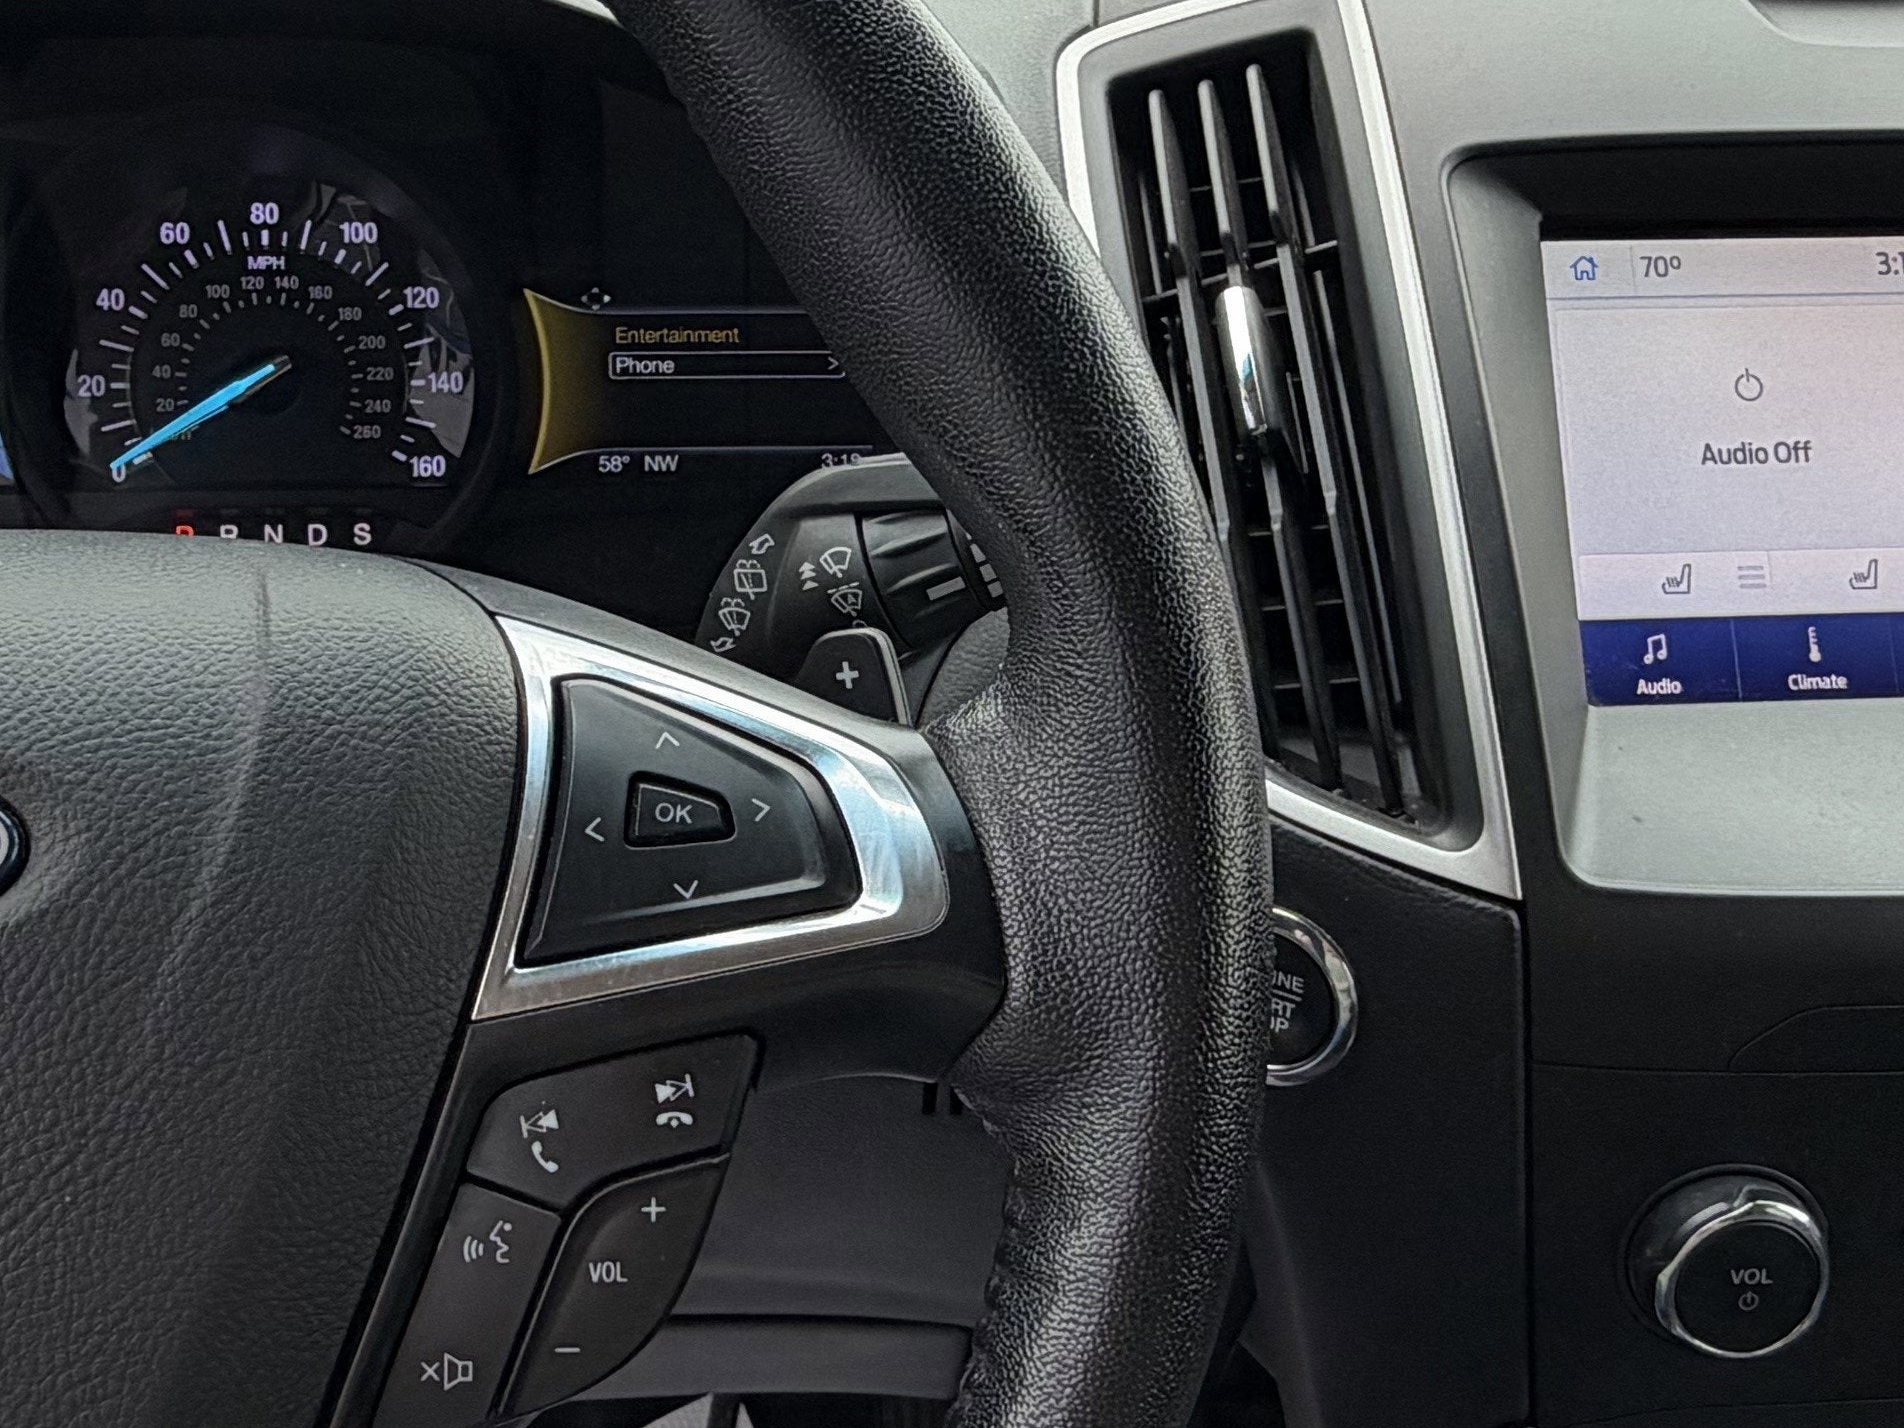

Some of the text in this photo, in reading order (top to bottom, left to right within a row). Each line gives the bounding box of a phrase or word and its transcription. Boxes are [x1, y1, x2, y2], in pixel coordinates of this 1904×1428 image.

[250, 203, 279, 224] 80
[160, 222, 190, 244] 60
[339, 222, 378, 244] 100
[247, 255, 285, 270] MPH
[1639, 255, 1682, 279] 70°
[240, 276, 264, 290] 120
[274, 276, 299, 290] 140
[96, 288, 125, 311] 40
[205, 285, 230, 300] 100
[308, 285, 332, 300] 160
[404, 287, 439, 309] 120
[179, 304, 198, 319] 80
[161, 334, 180, 348] 60
[359, 335, 386, 349] 200
[615, 326, 739, 344] Entertainment
[152, 364, 172, 378] 40
[615, 355, 674, 373] Phone
[367, 367, 394, 381] 220
[428, 373, 463, 393] 140
[77, 374, 106, 397] 20
[156, 398, 175, 412] 20
[365, 399, 391, 413] 240
[353, 424, 381, 439] 260
[1701, 439, 1812, 466] Audio Off
[409, 454, 446, 477] 160
[598, 454, 679, 472] 58° NW
[111, 463, 127, 483] 0
[264, 524, 283, 543] N
[307, 523, 327, 545] D
[353, 523, 372, 545] S
[1637, 677, 1682, 696] Audio
[1787, 671, 1849, 692] Climate
[654, 802, 694, 825] OK
[588, 1261, 628, 1283] VOL
[1729, 1268, 1775, 1286] VOL
